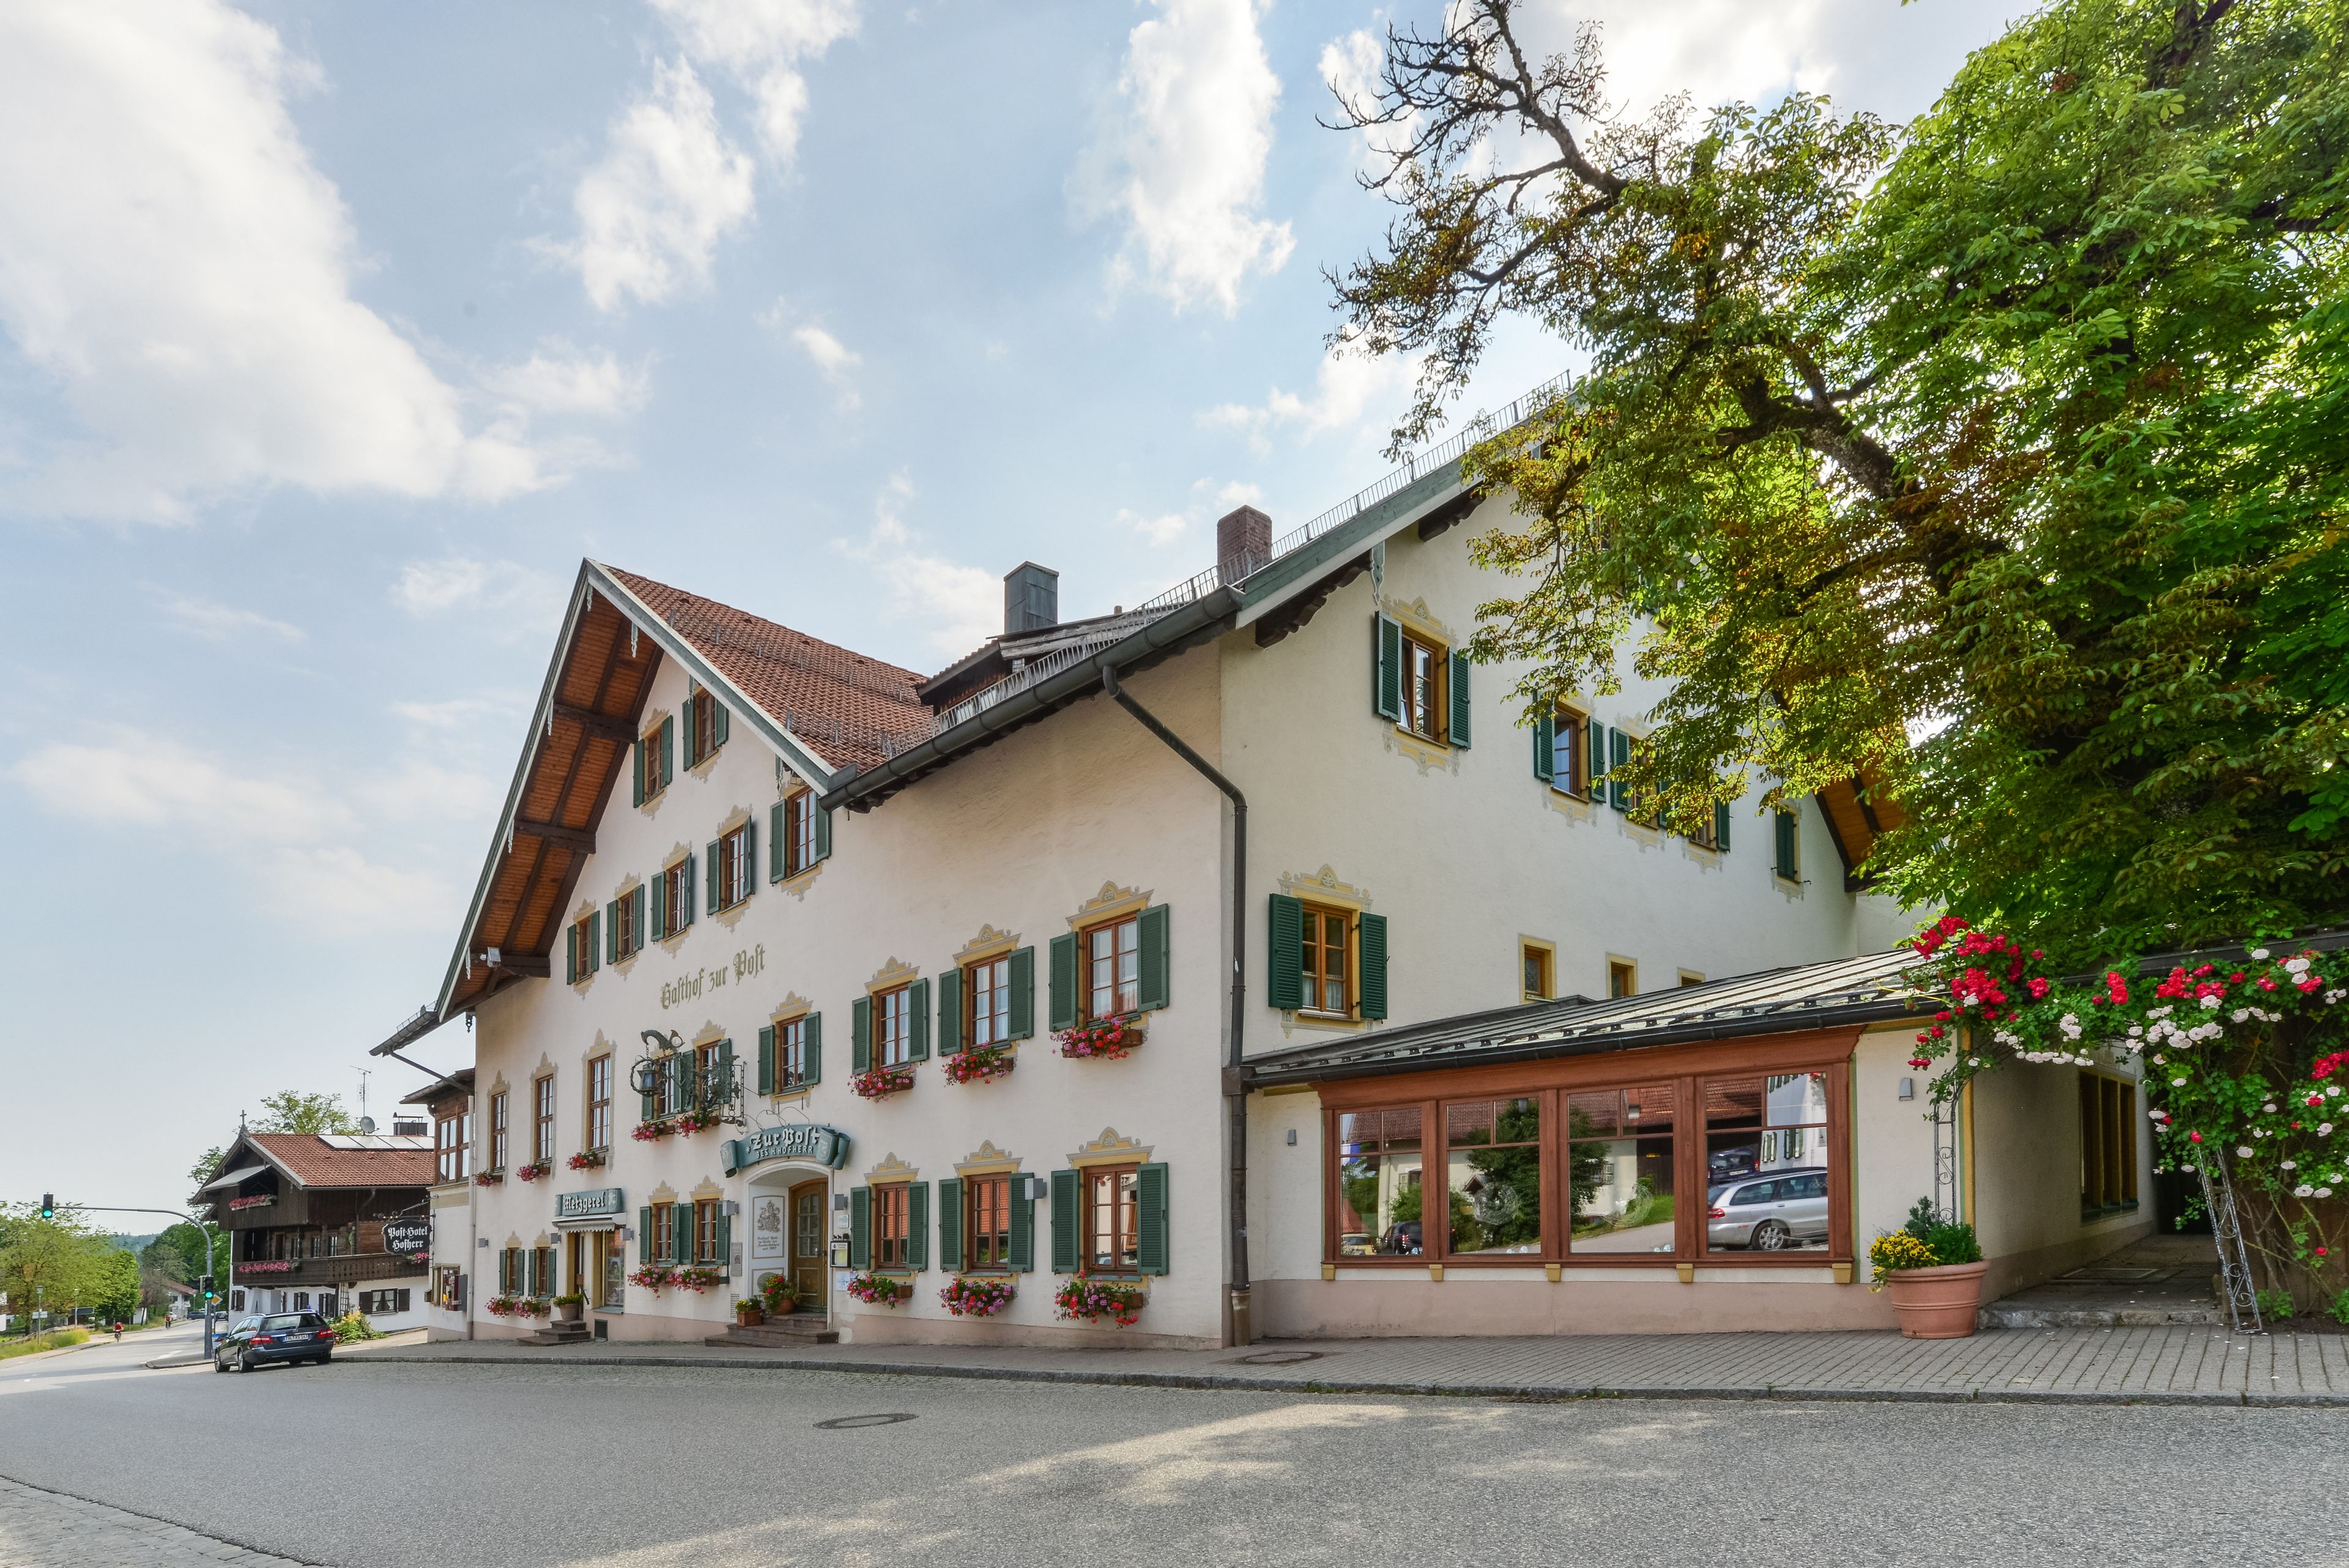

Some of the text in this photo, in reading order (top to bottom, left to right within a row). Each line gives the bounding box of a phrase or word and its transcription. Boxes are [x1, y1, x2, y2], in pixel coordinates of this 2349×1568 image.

[660, 942, 766, 1009] Gasthof zur Post
[749, 1126, 821, 1150] Zur Post
[563, 1191, 605, 1213] Metzgerei
[388, 1225, 428, 1240] Post-Hotel
[392, 1239, 424, 1252] Hofherr
